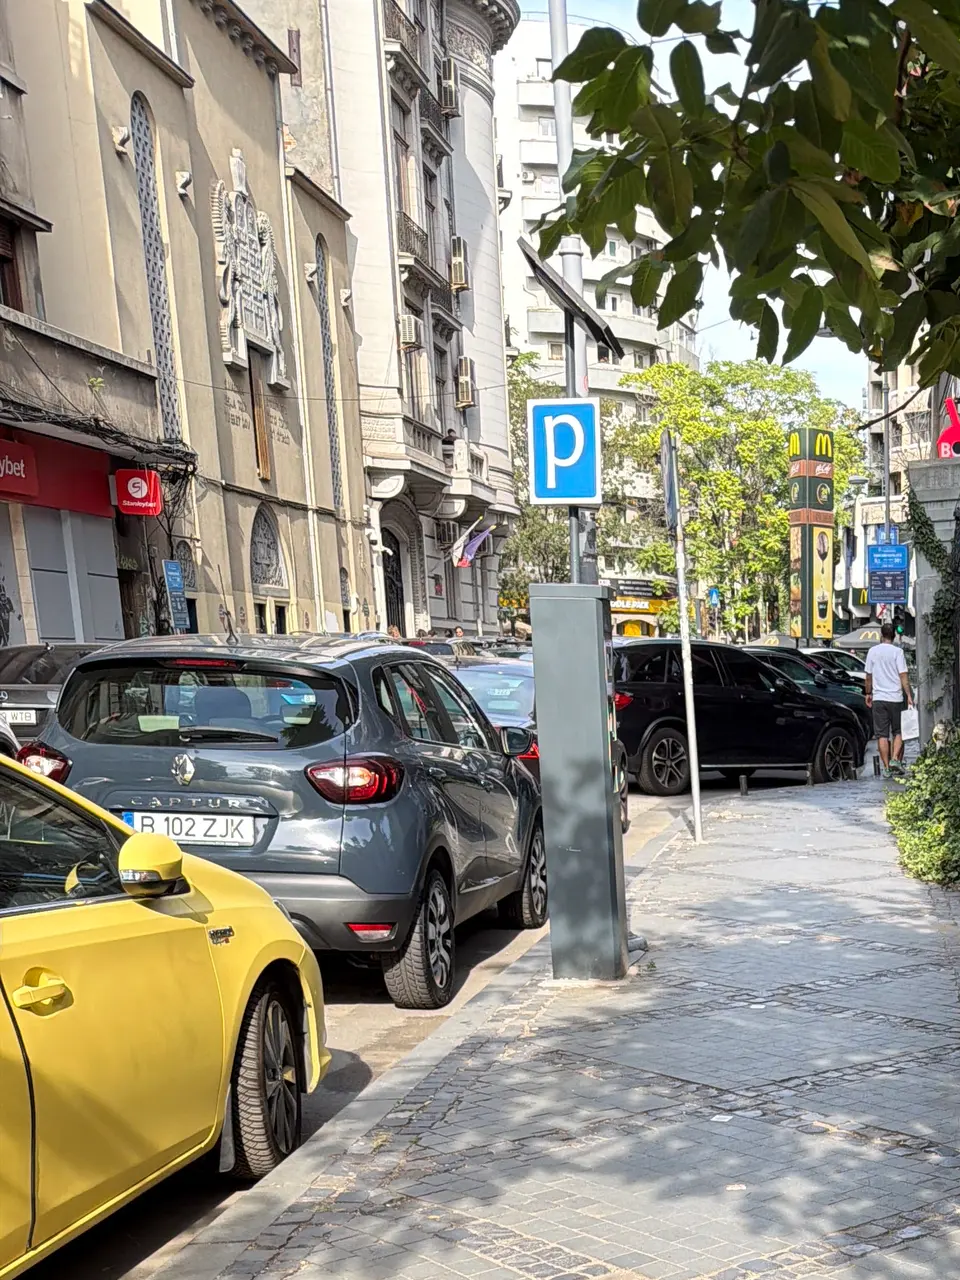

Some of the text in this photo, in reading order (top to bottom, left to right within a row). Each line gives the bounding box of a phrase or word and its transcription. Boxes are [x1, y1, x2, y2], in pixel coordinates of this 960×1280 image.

[122, 499, 157, 508] Stanleybet
[131, 796, 241, 809] CAPTUR
[140, 815, 244, 839] B 102 ZJK
